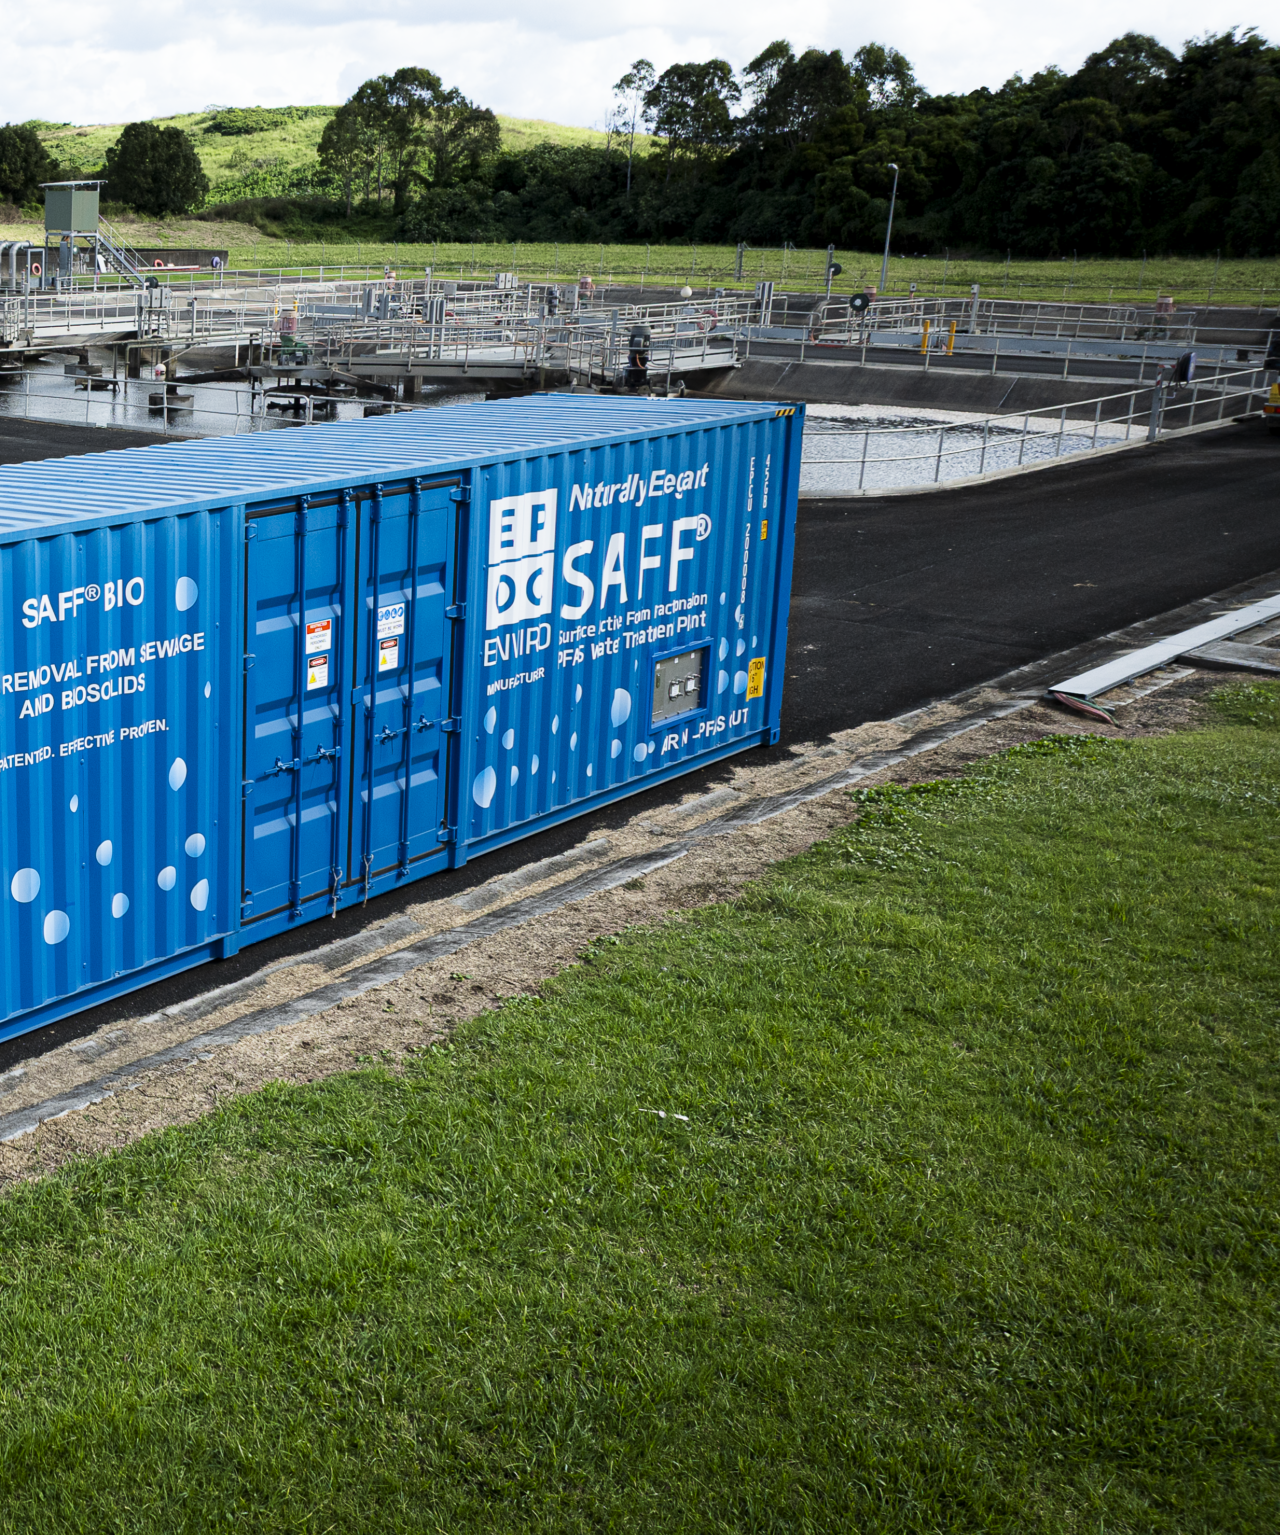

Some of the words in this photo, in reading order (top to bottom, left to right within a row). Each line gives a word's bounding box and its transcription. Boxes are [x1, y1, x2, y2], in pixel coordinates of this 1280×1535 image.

[648, 462, 710, 500] Eegat
[21, 584, 101, 629] SAFF®
[104, 576, 145, 612] BIO
[558, 624, 596, 645] Surfce
[590, 636, 620, 661] Wate
[676, 610, 707, 634] Plnt
[2, 659, 82, 695] REMOVAL
[86, 647, 136, 675] FROM
[140, 632, 206, 664] SEWAGE
[19, 693, 55, 719] AND
[61, 673, 146, 711] BIOSOLIDS
[59, 730, 115, 757] EFFECTIVE
[120, 718, 170, 741] PROVEN.
